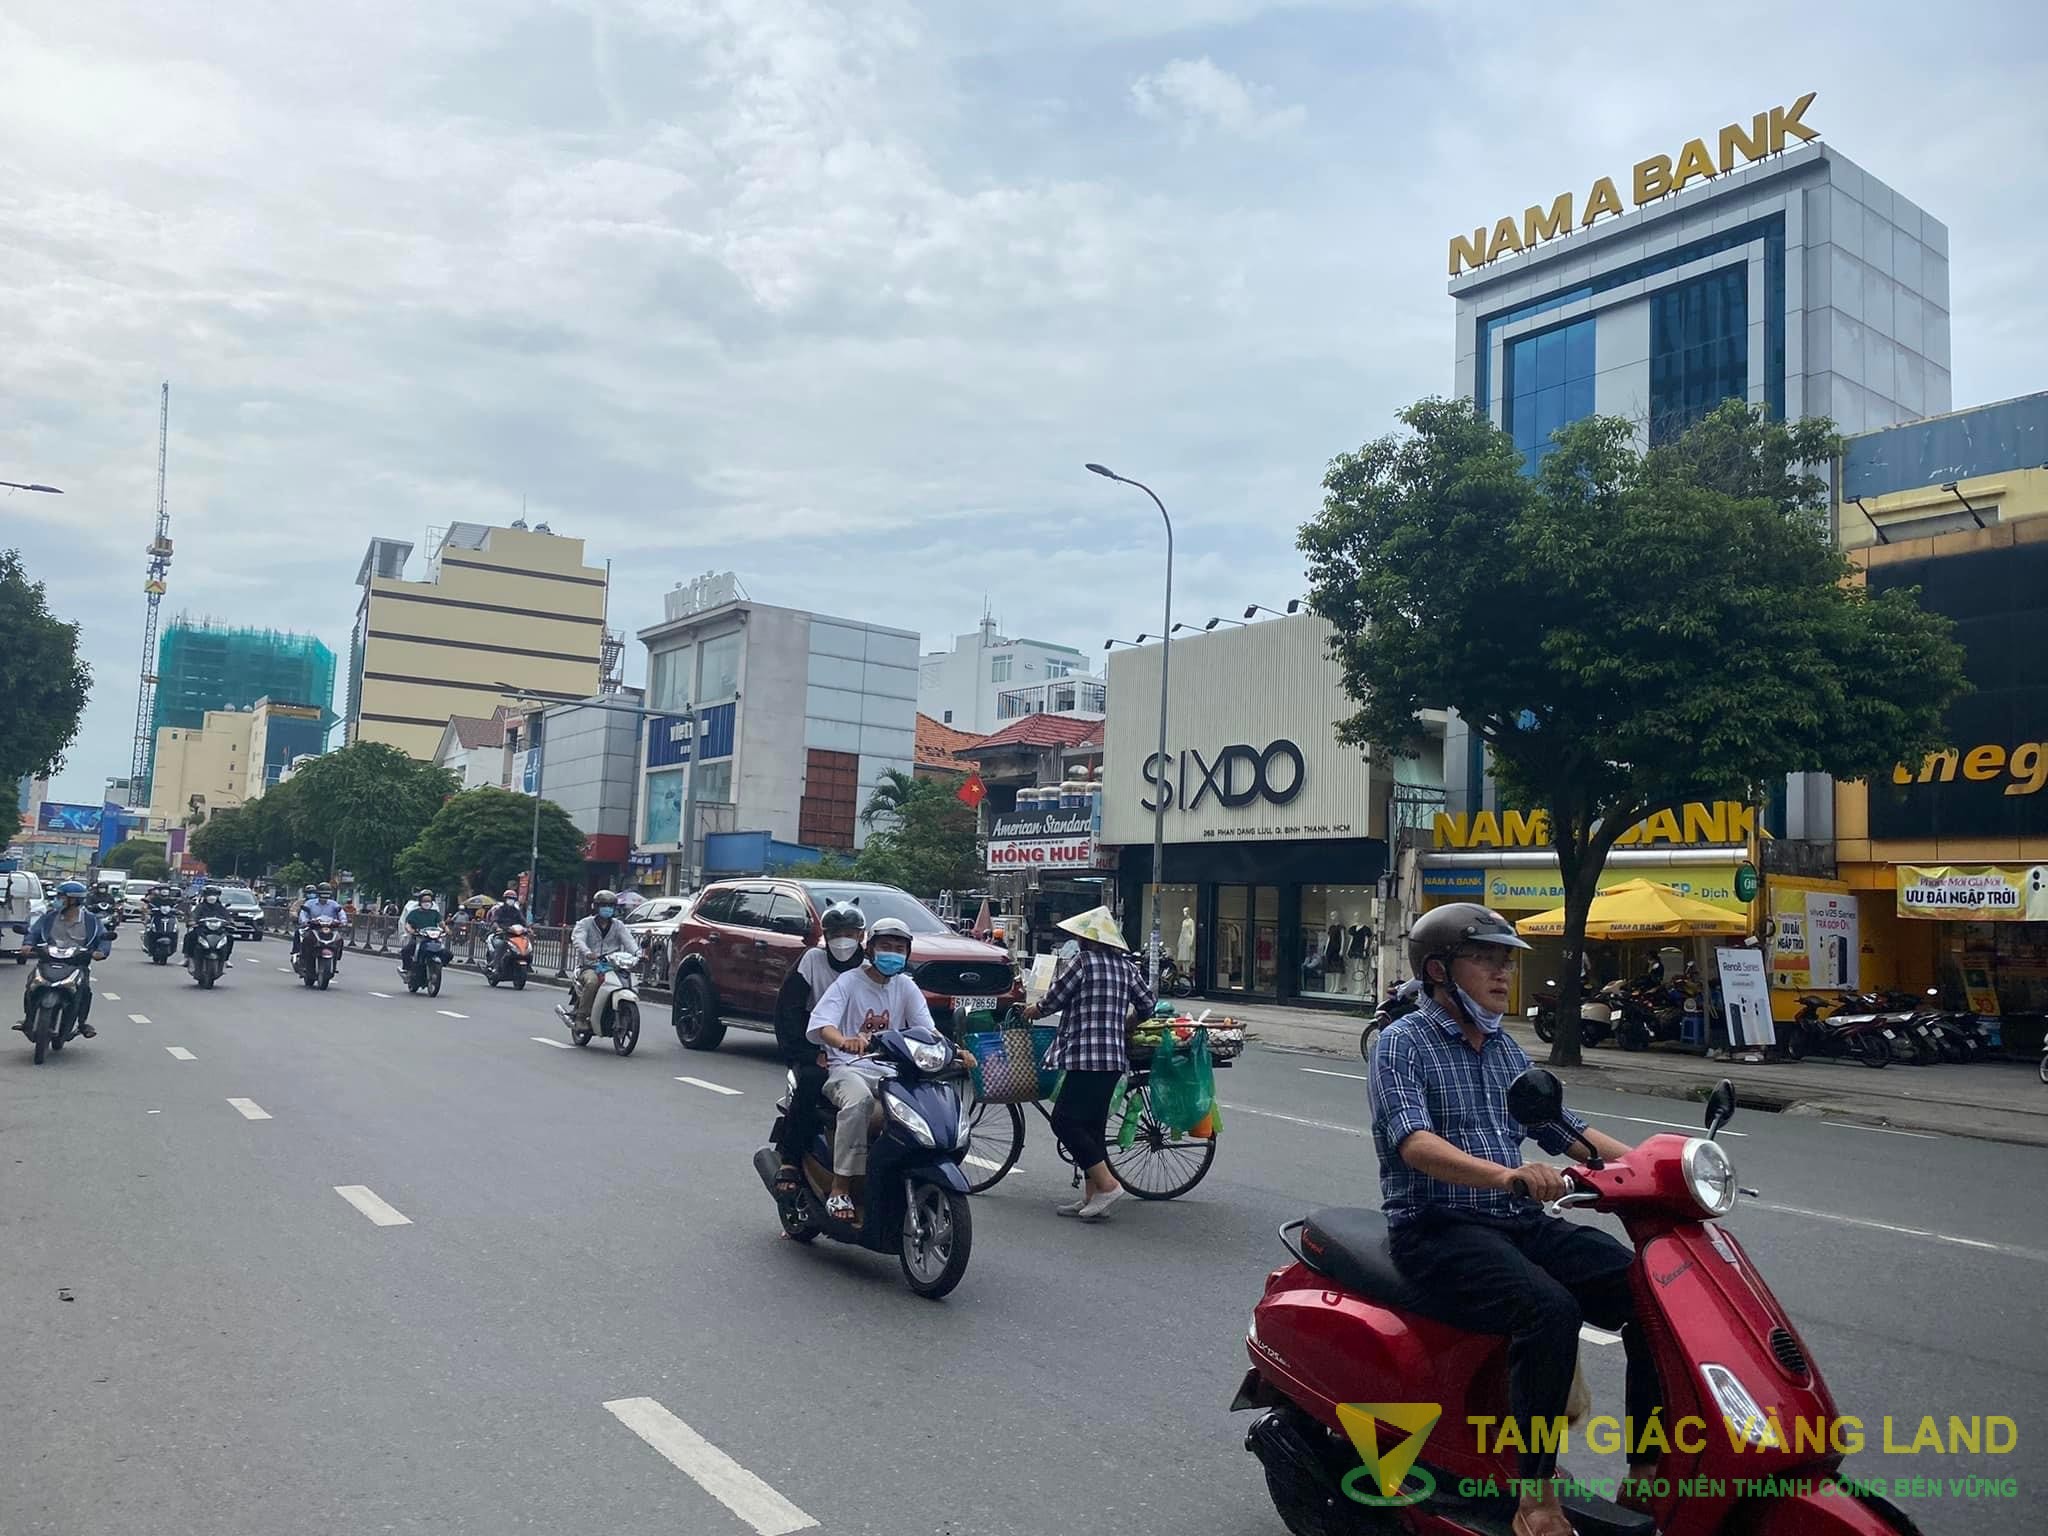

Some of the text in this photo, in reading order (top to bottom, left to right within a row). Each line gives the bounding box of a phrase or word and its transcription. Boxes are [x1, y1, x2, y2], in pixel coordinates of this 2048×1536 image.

[1449, 91, 1821, 275] NAM A BANK
[1140, 738, 1306, 812] SIXDO
[992, 812, 1092, 837] American Standard
[1433, 808, 1549, 849] NAM
[991, 842, 1045, 863] HỒNG
[1423, 877, 1482, 887] NAM A BANK
[1492, 882, 1508, 896] 30
[1510, 886, 1537, 896] NAM
[1539, 886, 1548, 896] A
[1906, 889, 1924, 903] ƯU
[1926, 888, 1947, 904] ĐÃI
[1949, 888, 1985, 907] NGẬP
